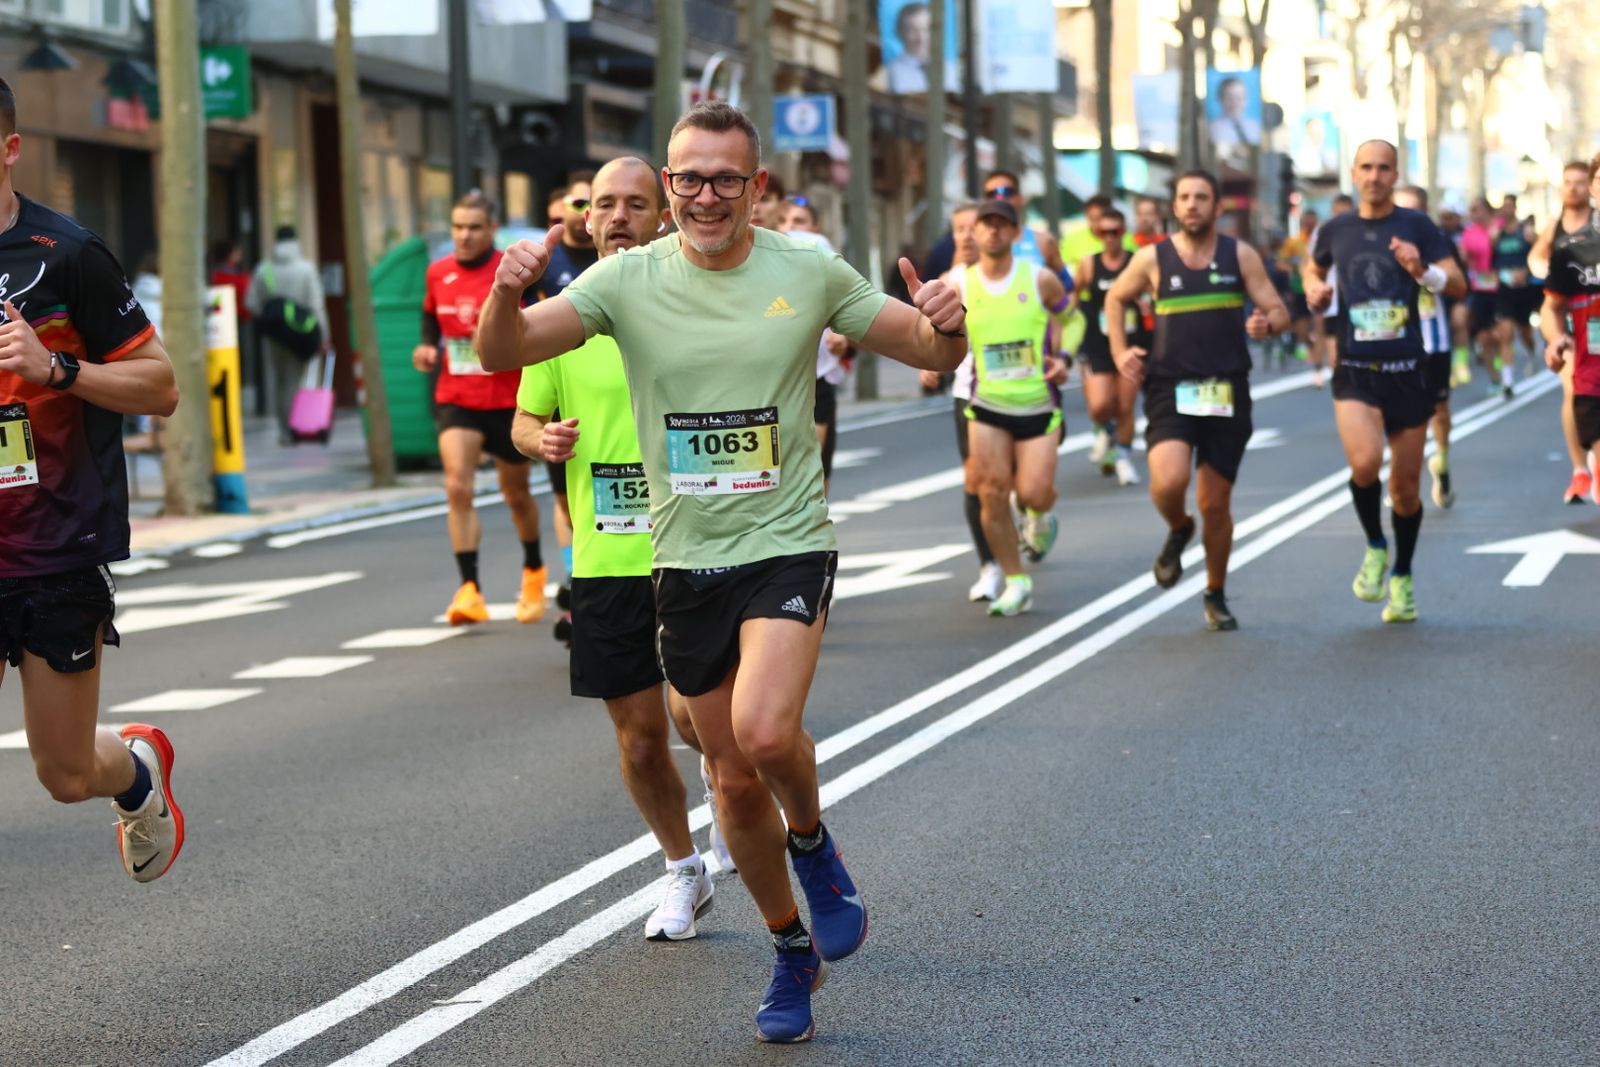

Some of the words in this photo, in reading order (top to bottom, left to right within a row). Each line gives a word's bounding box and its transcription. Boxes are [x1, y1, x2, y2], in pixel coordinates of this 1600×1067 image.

[29, 234, 58, 248] 42K
[725, 414, 747, 424] 2026
[688, 431, 759, 456] 1063
[711, 458, 735, 466] MIGUE
[676, 480, 703, 488] LABORAL
[732, 479, 771, 490] bedunia
[781, 604, 810, 617] adidas
